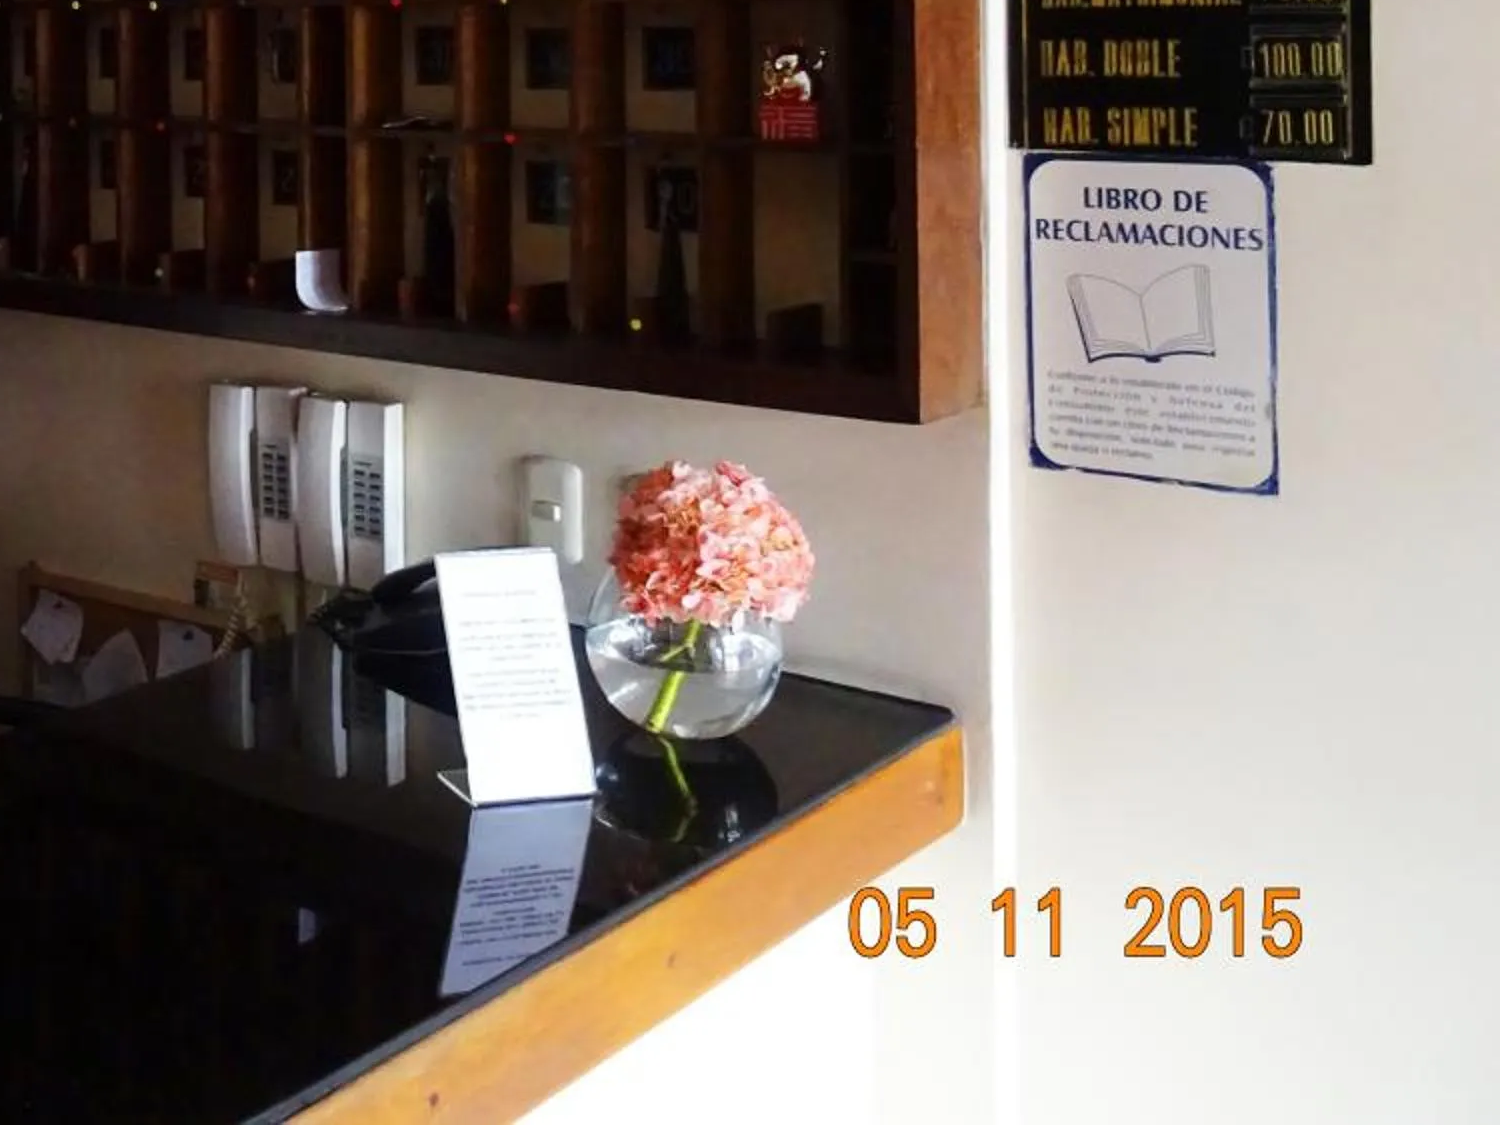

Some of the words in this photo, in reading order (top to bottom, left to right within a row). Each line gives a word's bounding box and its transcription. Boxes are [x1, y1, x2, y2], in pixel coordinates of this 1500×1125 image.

[1103, 38, 1182, 78] DOBLE
[1258, 40, 1344, 80] 100.00
[1106, 106, 1199, 147] SIMPLE
[1260, 109, 1334, 147] 70.00
[1083, 186, 1162, 212] LIBRO
[1173, 190, 1209, 214] DE
[1035, 218, 1264, 252] RECLAMACIONES
